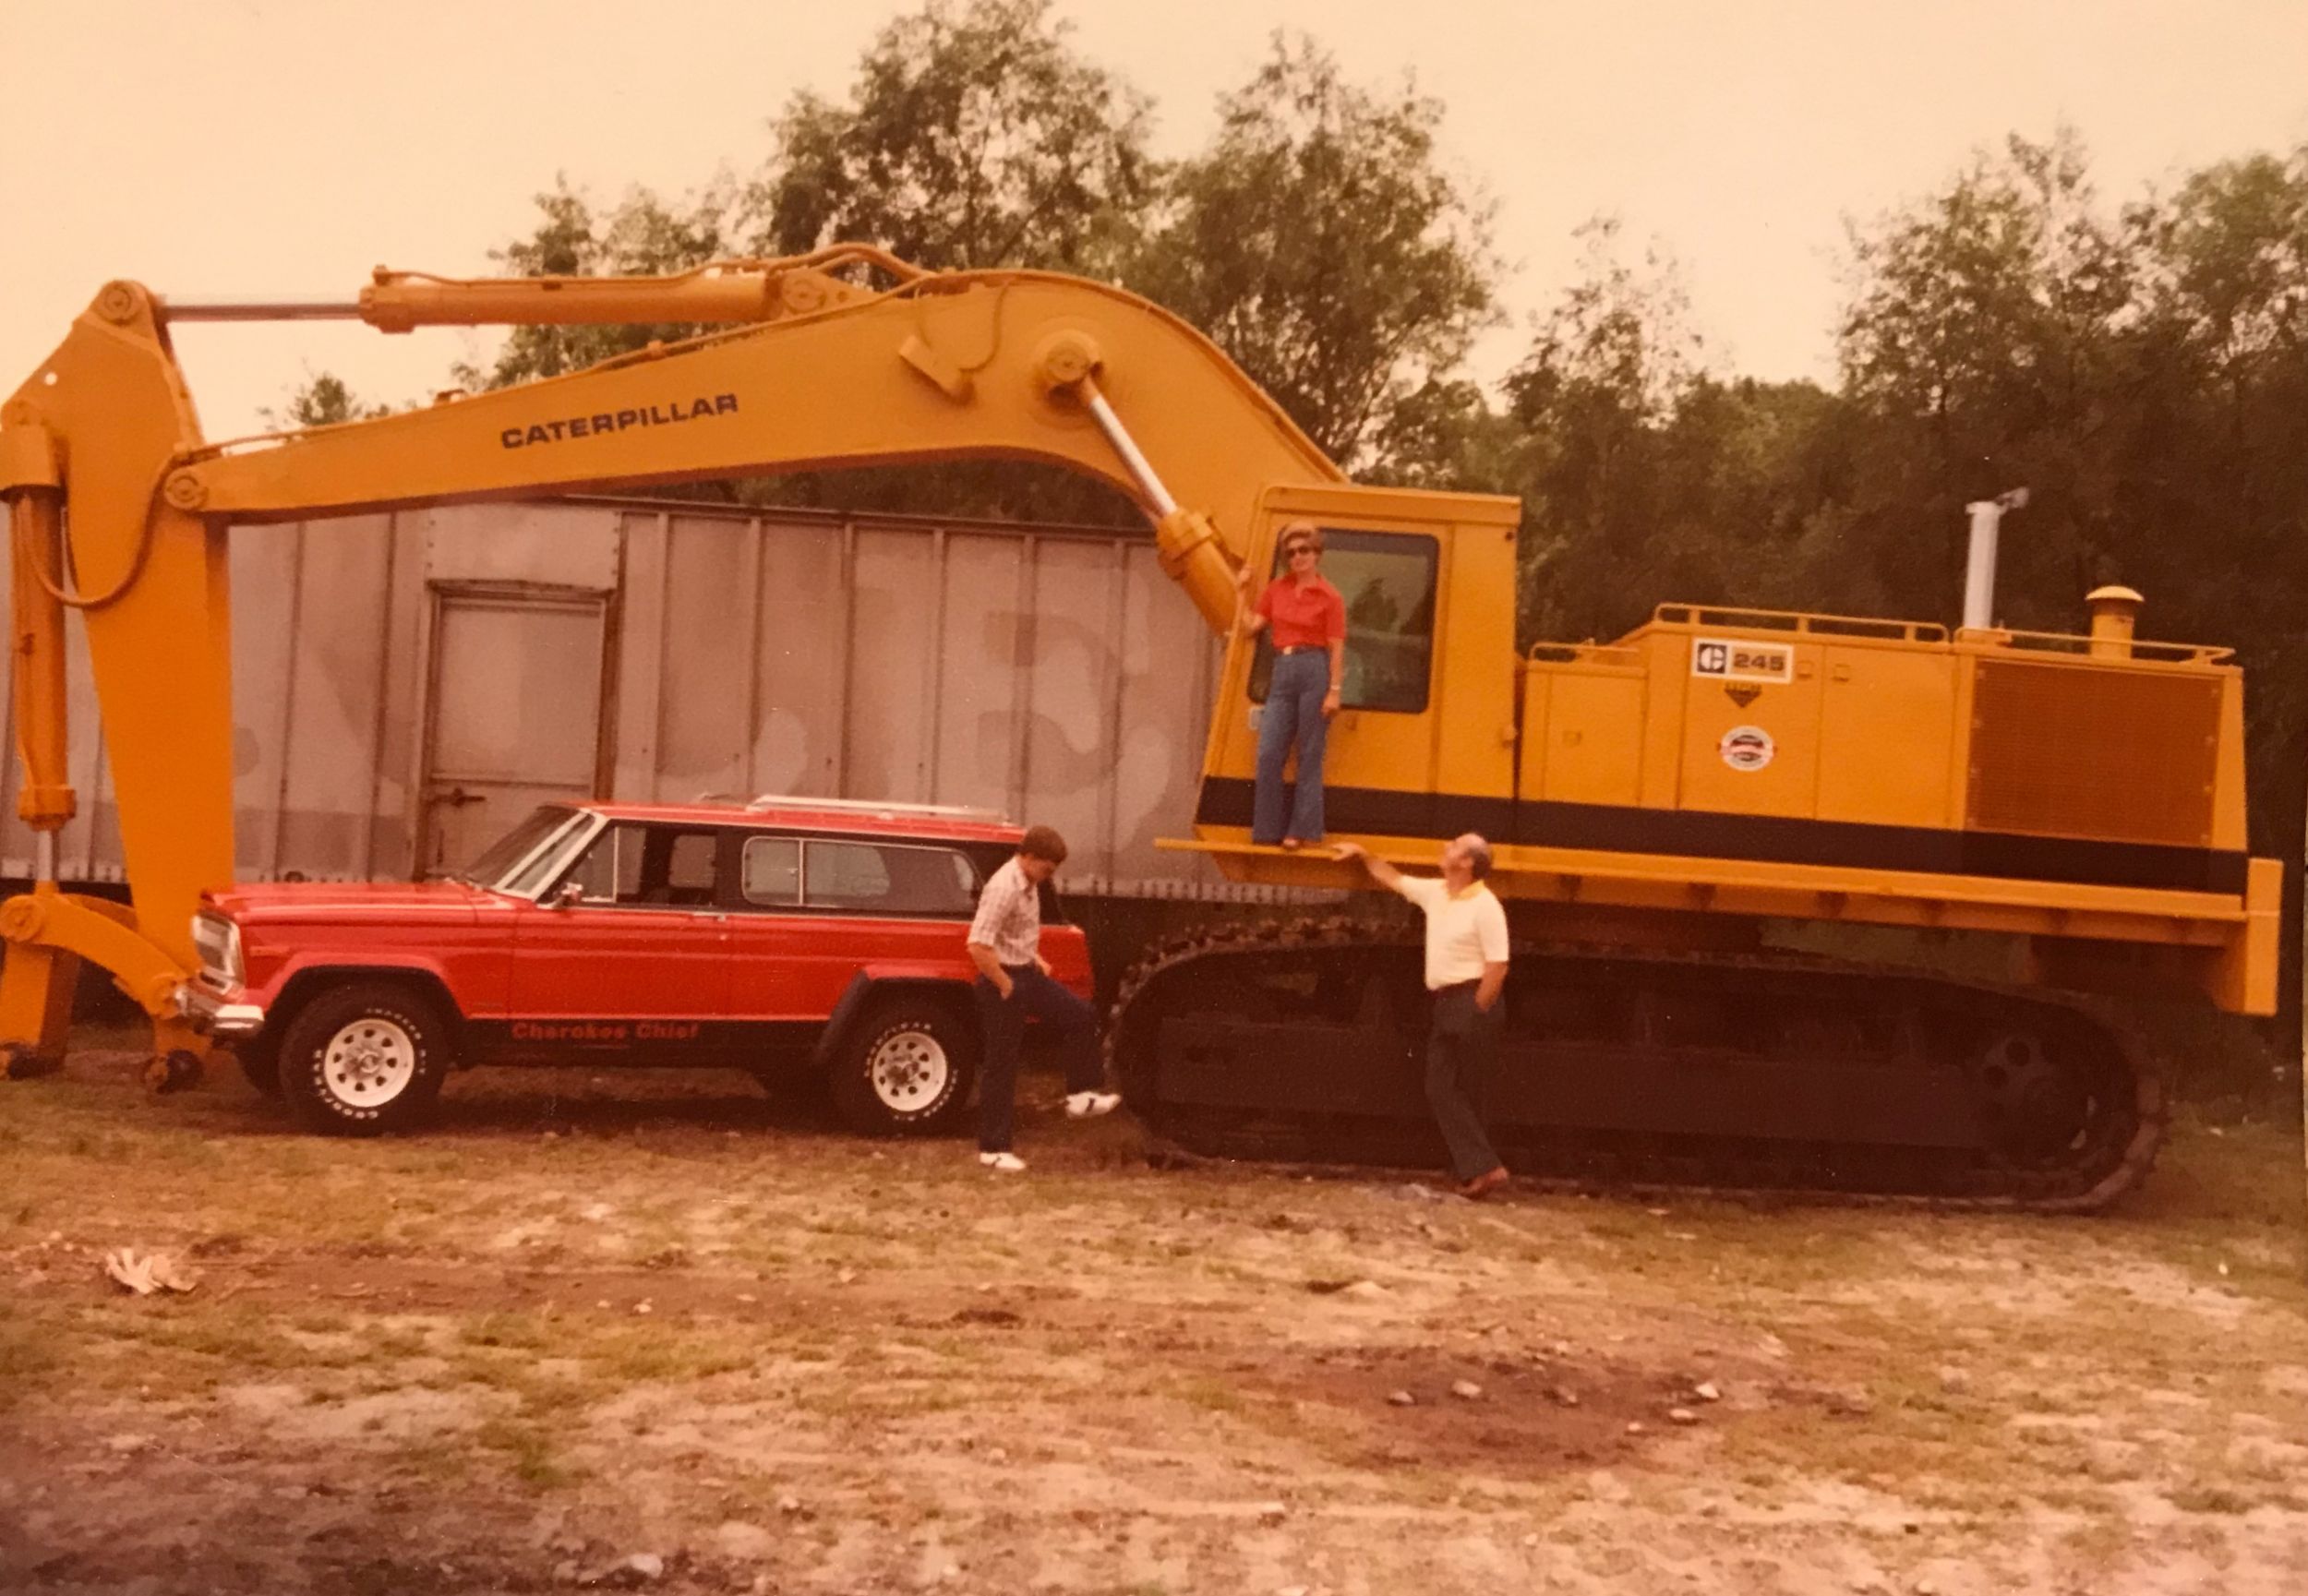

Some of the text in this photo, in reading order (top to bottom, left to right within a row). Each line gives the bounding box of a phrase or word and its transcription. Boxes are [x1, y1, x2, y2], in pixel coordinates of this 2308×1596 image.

[500, 393, 739, 450] CATERPILLAR
[1733, 653, 1785, 672] 245
[511, 1022, 699, 1040] Cherokee Chief
